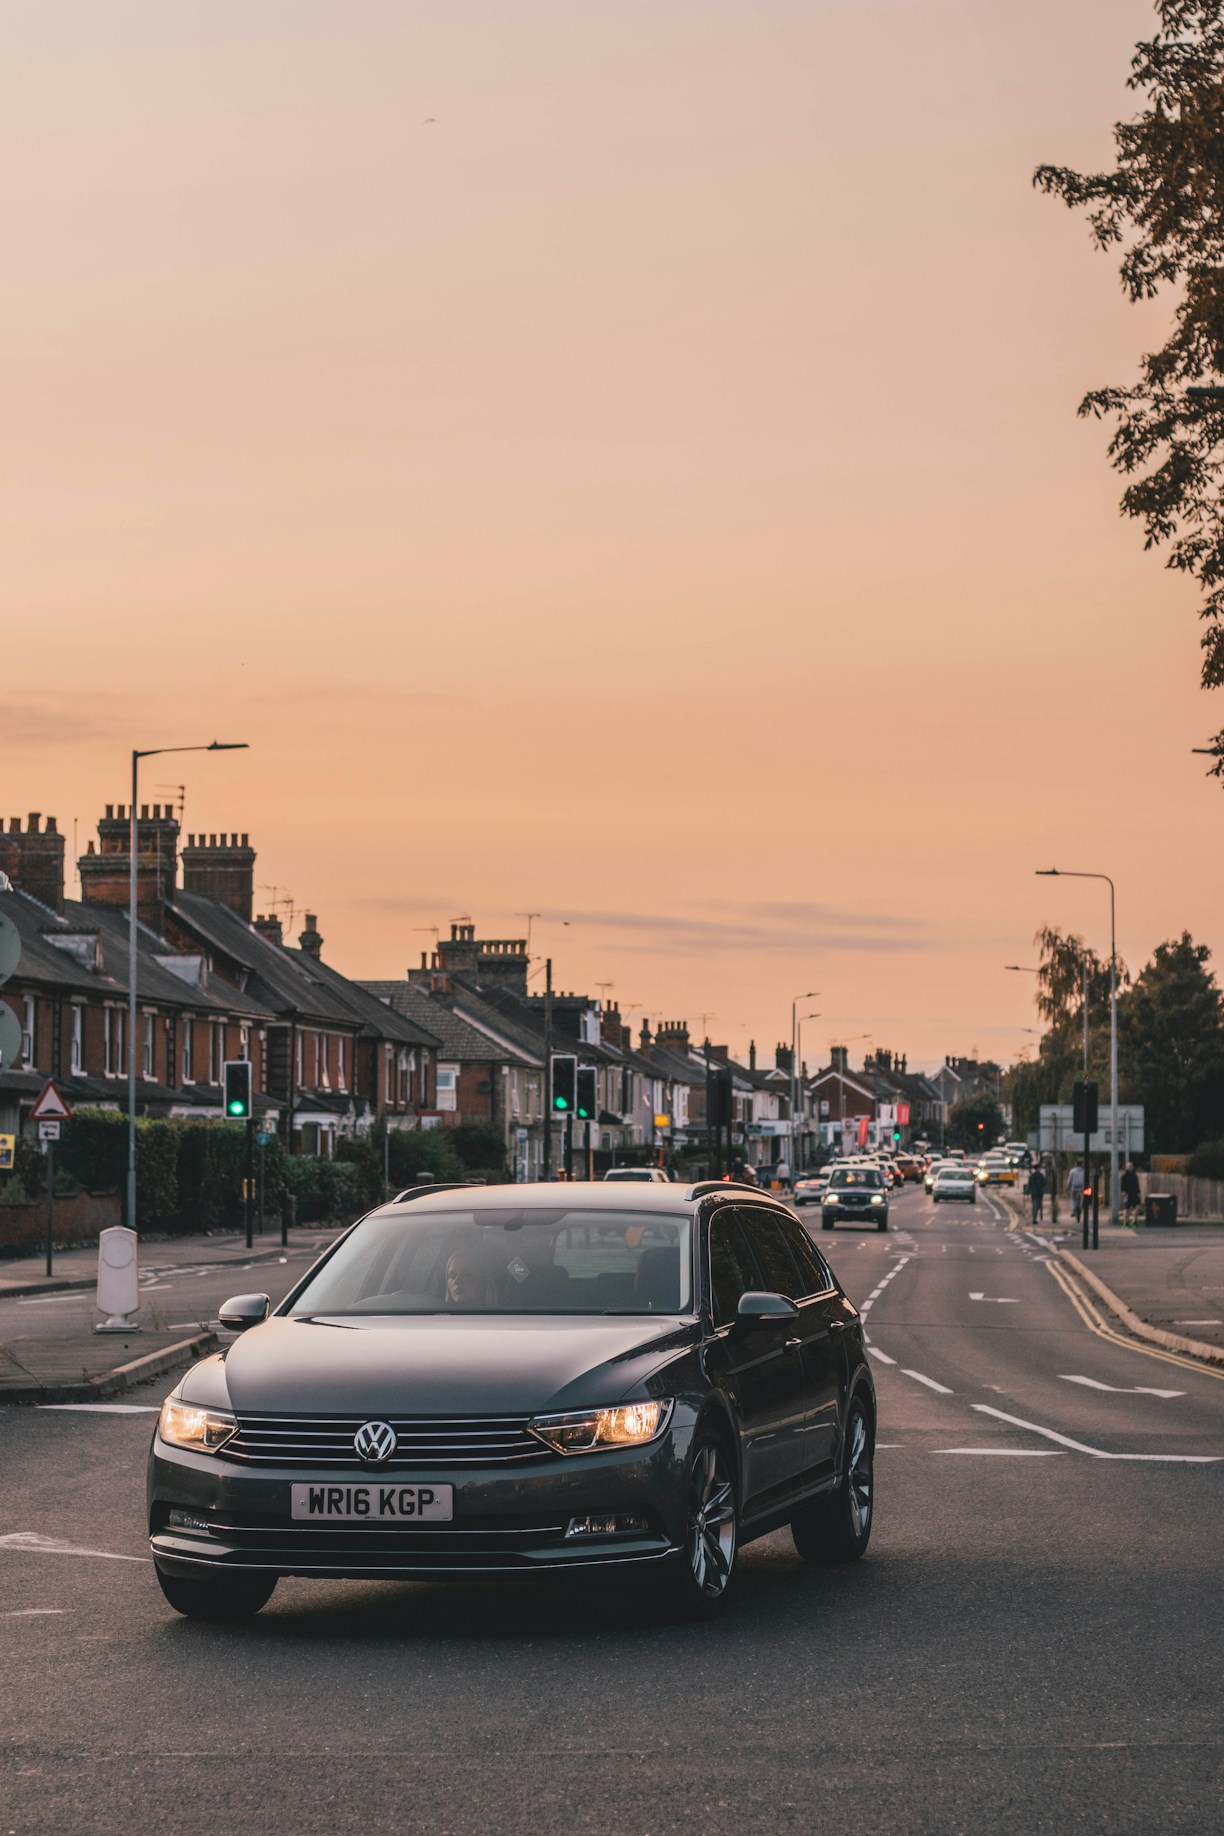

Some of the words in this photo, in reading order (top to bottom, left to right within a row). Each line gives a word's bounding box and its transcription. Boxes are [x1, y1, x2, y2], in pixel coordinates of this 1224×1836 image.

[354, 1421, 397, 1463] VW
[309, 1488, 370, 1515] WR16
[379, 1488, 434, 1515] KGP
